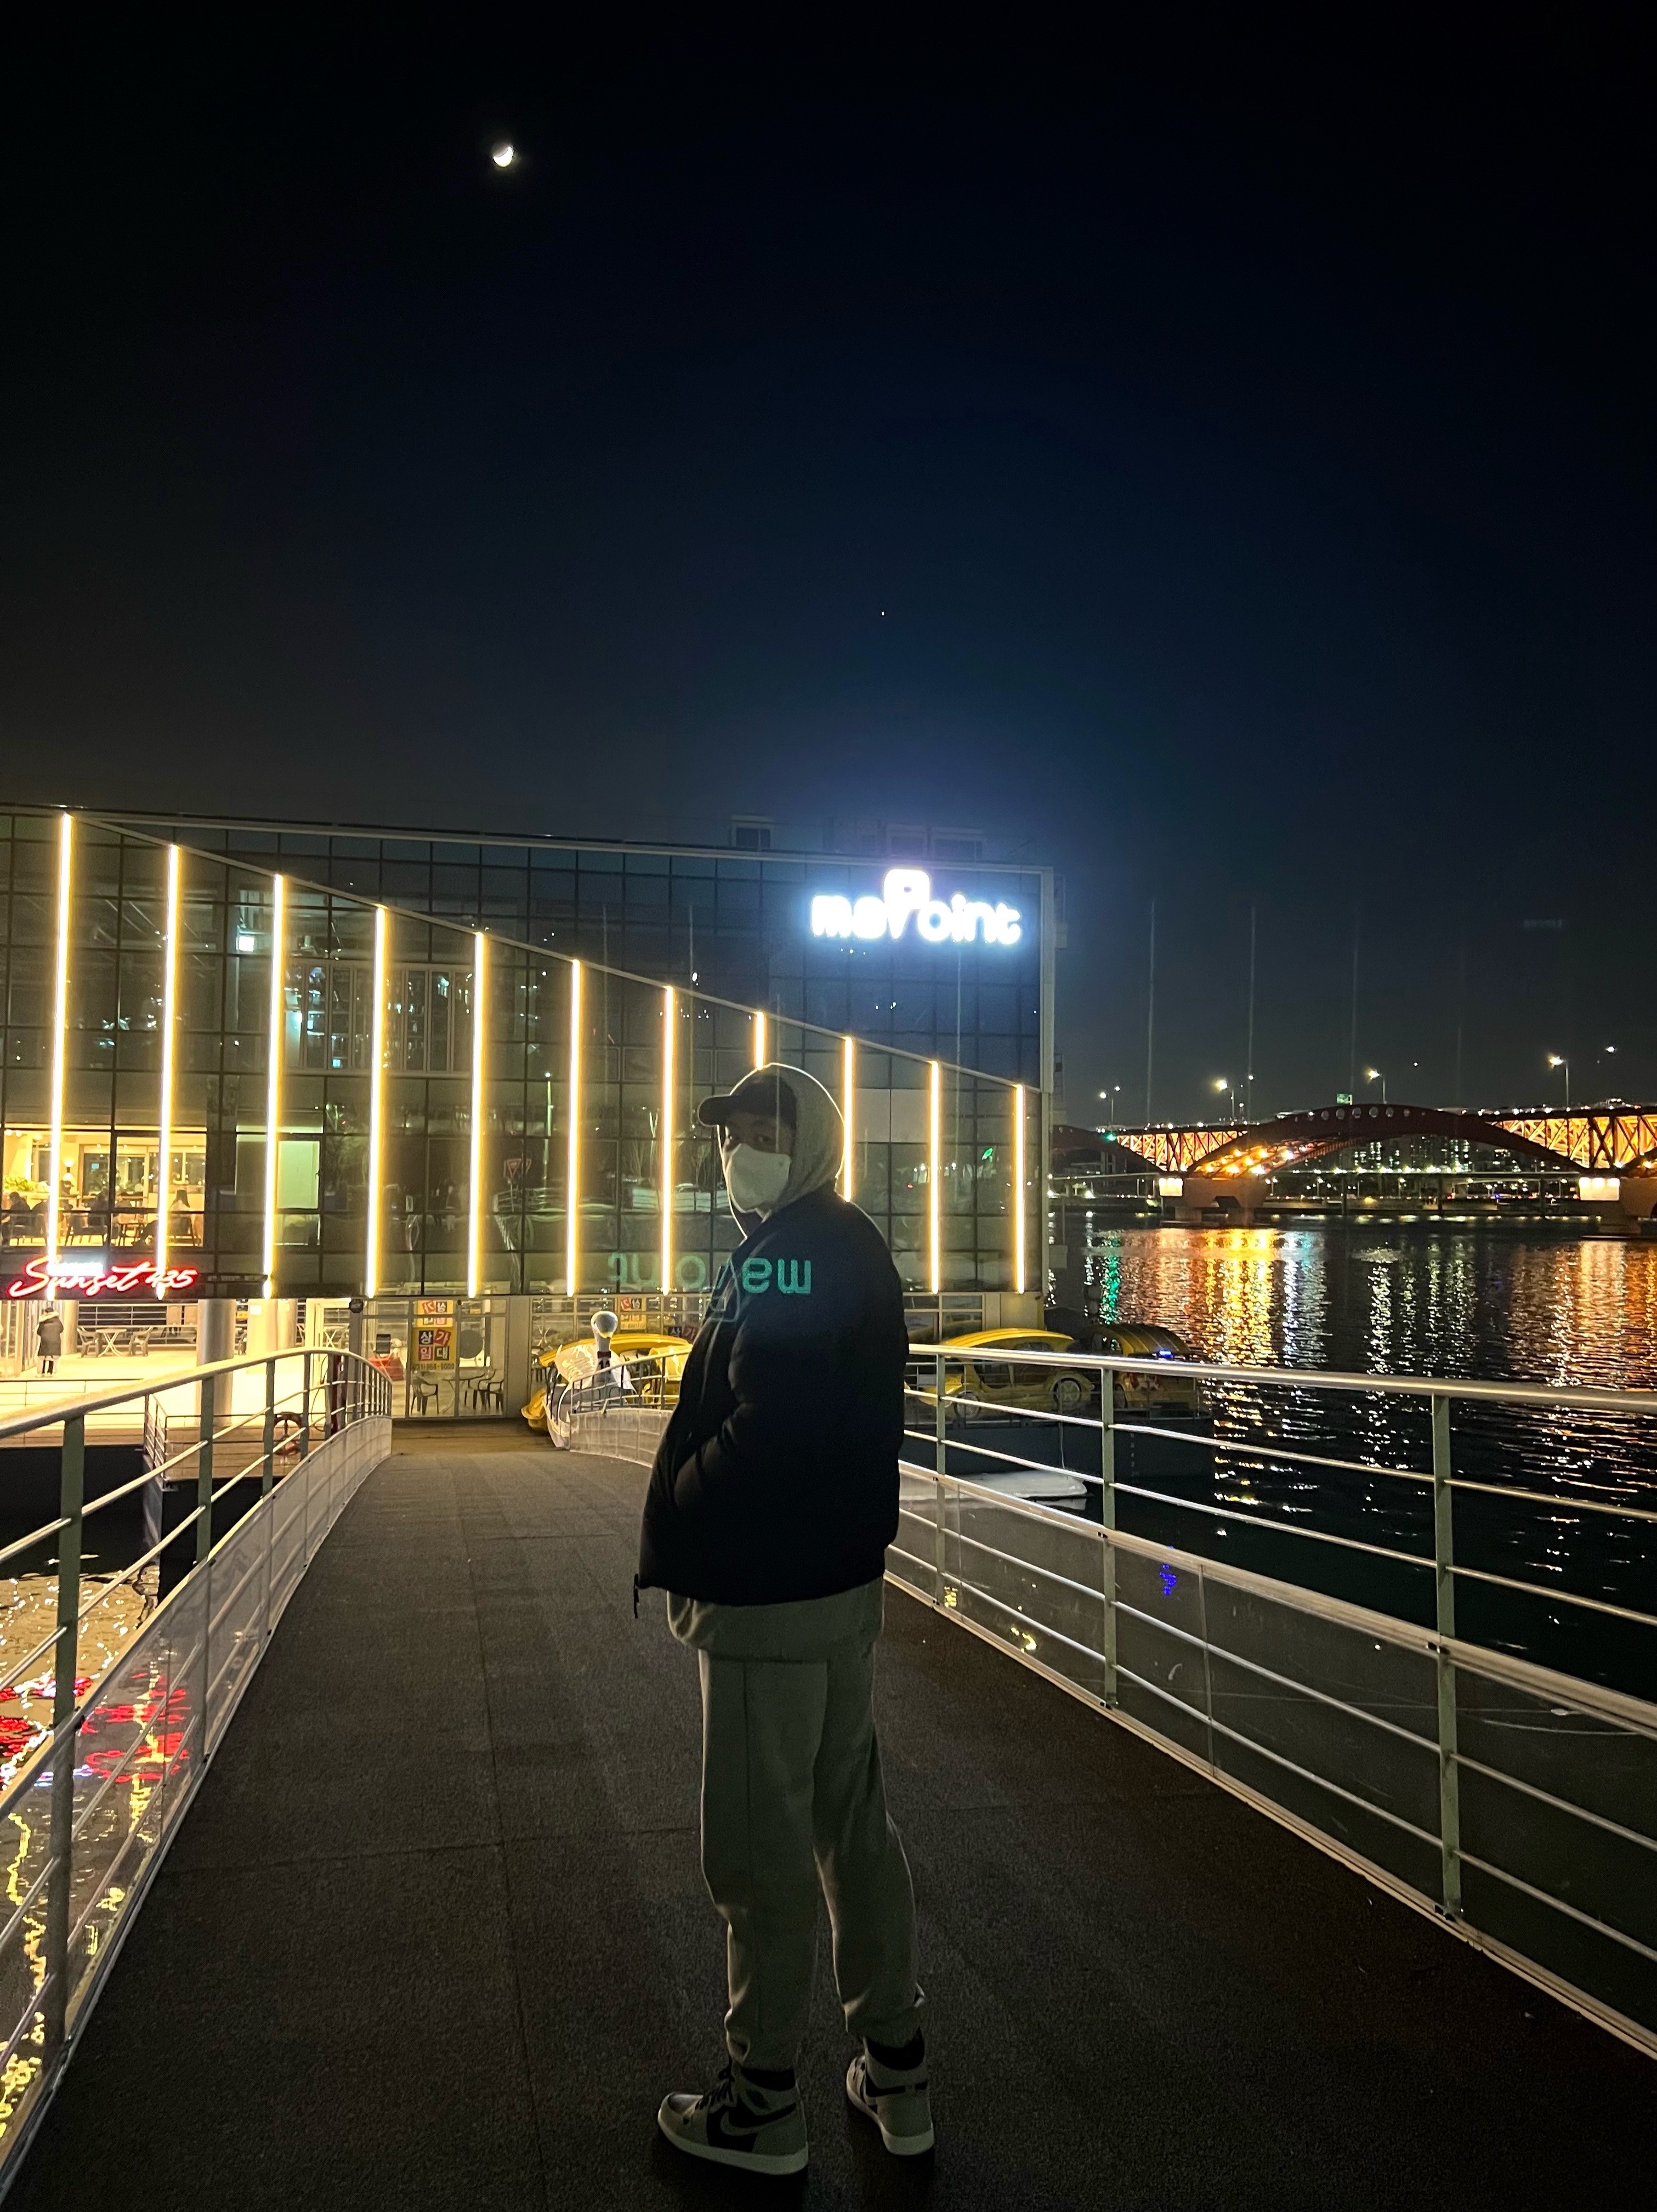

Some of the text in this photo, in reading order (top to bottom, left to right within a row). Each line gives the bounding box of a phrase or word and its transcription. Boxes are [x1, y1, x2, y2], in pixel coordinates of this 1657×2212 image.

[8, 1254, 152, 1298] Sunset
[420, 1331, 449, 1345] 상가
[420, 1346, 448, 1360] 임대
